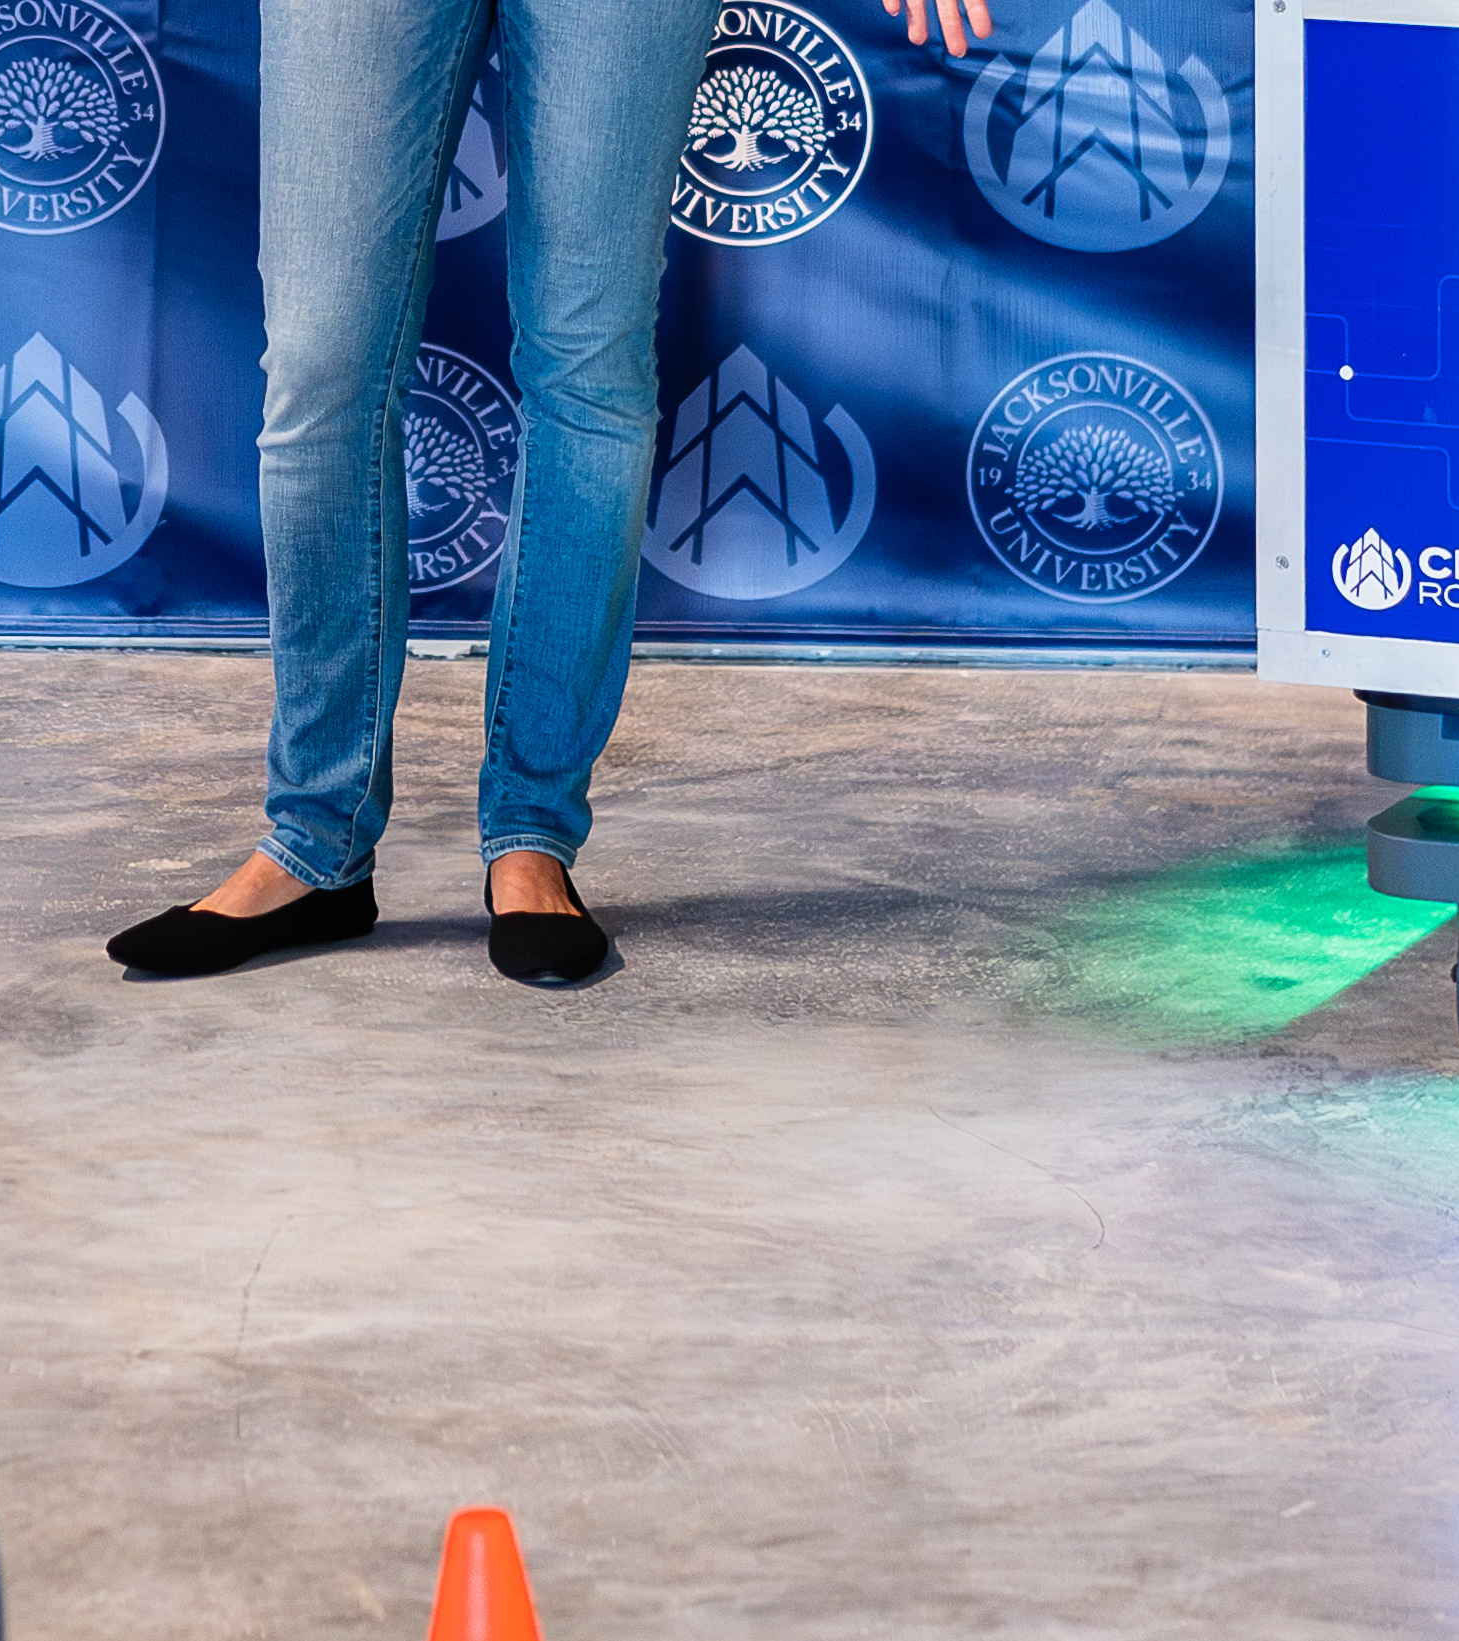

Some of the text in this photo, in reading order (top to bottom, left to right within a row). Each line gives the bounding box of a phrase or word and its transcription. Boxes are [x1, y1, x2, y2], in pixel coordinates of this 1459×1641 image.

[711, 7, 855, 105] ONVILLE
[129, 103, 154, 122] 34
[836, 112, 862, 131] 34
[982, 363, 1206, 464] JACKSONVILLE
[978, 467, 1212, 491] 19 34
[990, 507, 1199, 591] UNIVERSITY
